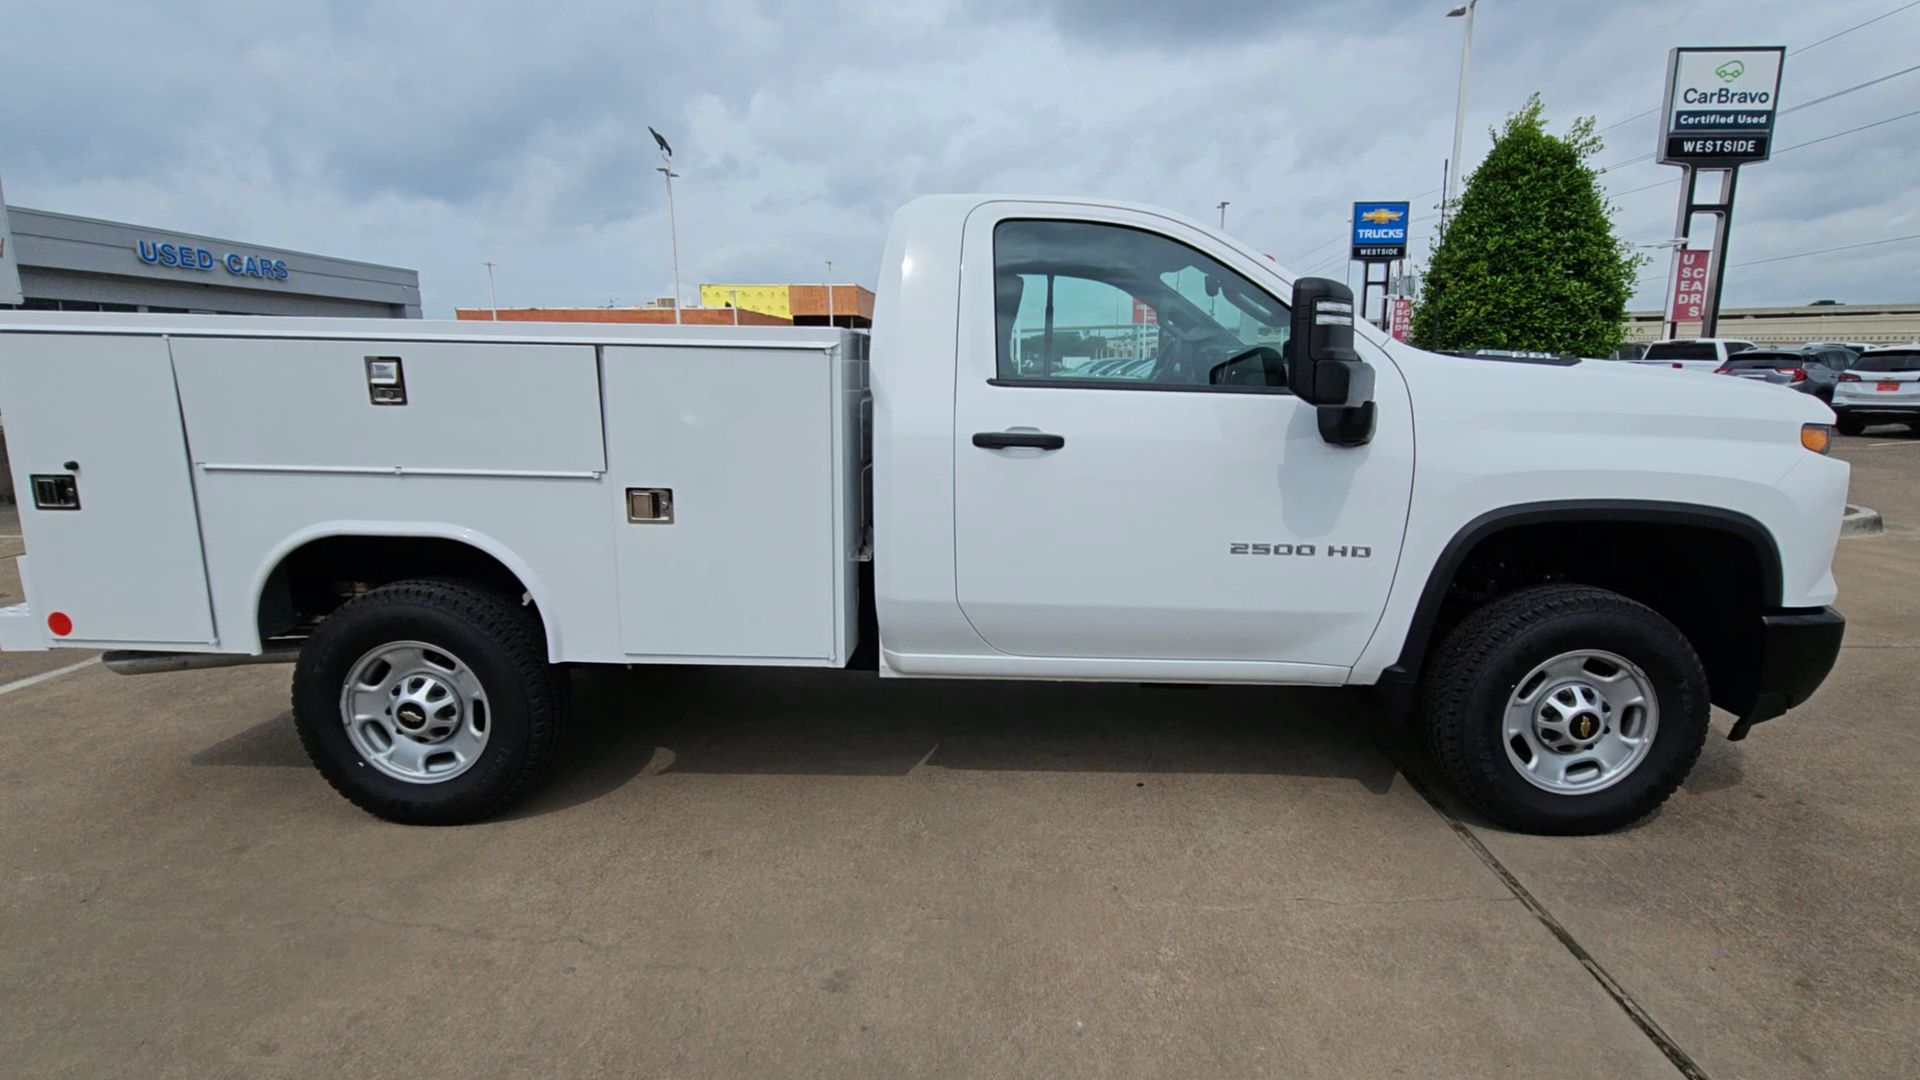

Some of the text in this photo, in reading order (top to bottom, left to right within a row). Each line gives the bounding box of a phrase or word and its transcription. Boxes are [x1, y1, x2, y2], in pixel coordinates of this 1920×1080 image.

[1683, 88, 1769, 104] CarBravo
[1680, 115, 1767, 124] Certified Used
[1683, 141, 1755, 152] WESTSIDE
[1358, 229, 1404, 238] TRUCKS
[136, 239, 289, 281] USED CARS
[1230, 543, 1372, 558] 2500 HD
